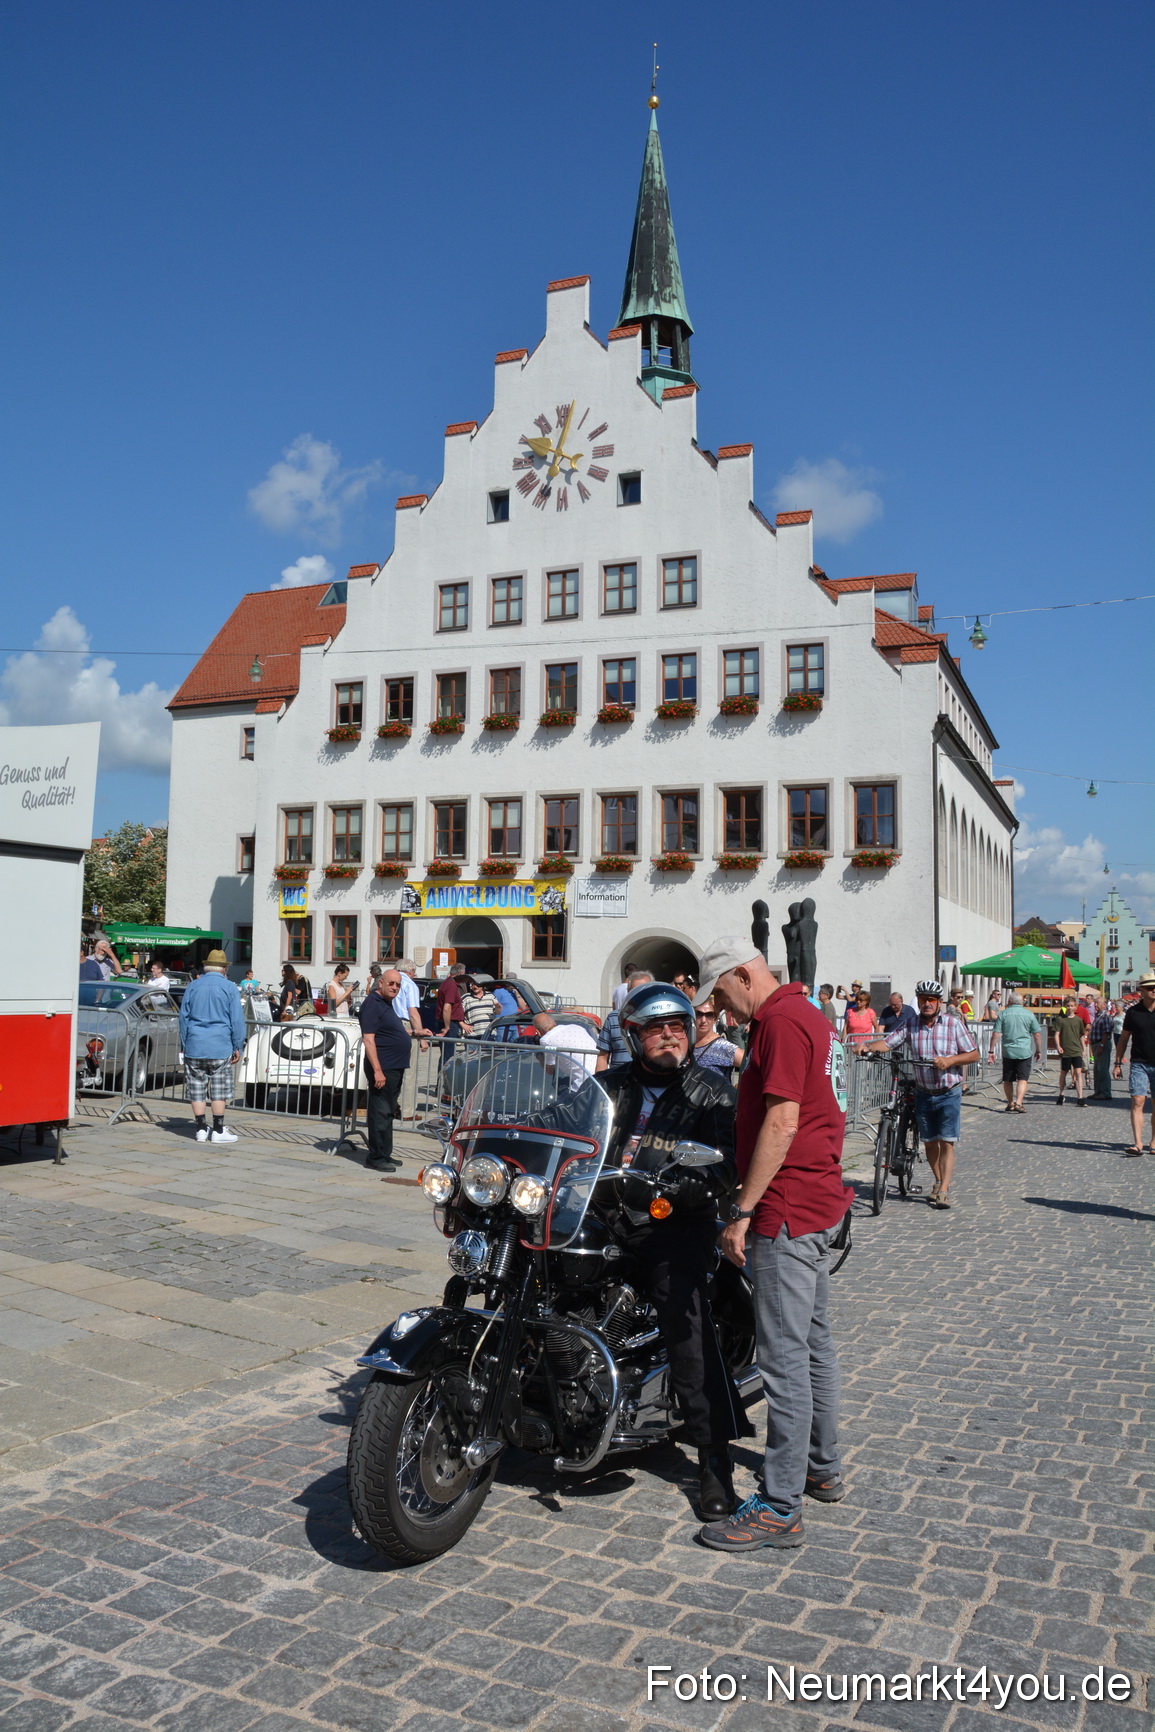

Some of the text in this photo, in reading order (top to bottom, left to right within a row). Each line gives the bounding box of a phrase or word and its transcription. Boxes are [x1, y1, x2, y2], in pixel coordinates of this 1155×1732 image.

[0, 756, 70, 786] Genuss und
[21, 785, 76, 811] Qualität!
[282, 886, 307, 907] WC
[425, 885, 536, 909] ANMELDUNG
[578, 892, 626, 902] Information
